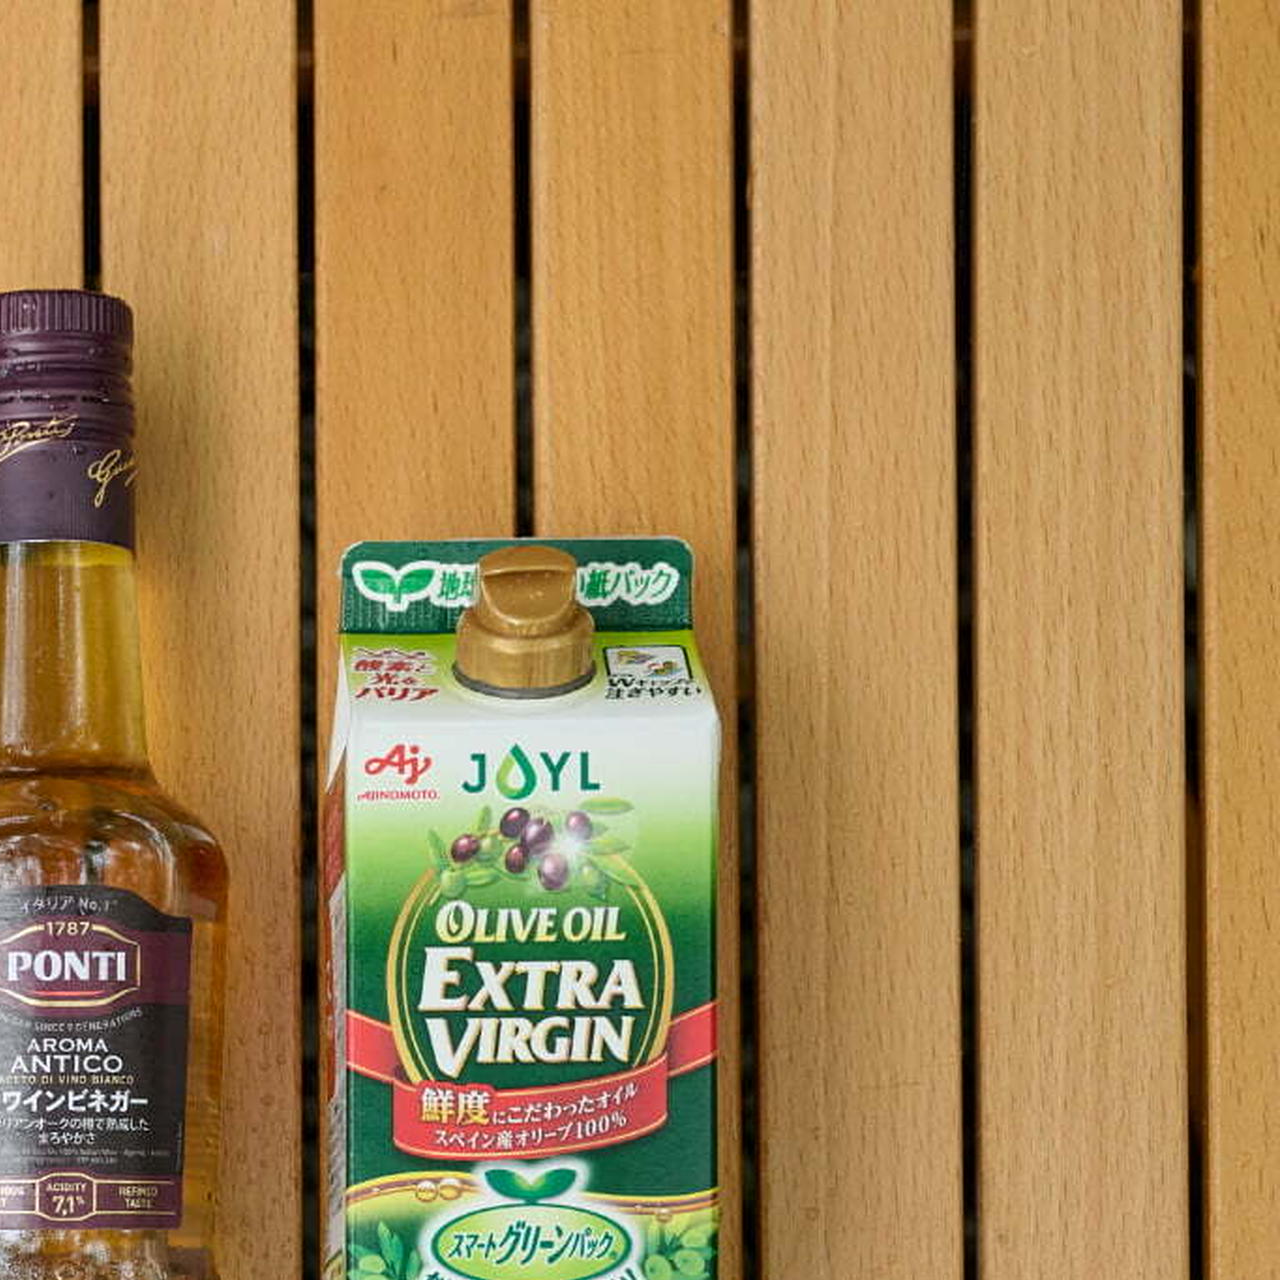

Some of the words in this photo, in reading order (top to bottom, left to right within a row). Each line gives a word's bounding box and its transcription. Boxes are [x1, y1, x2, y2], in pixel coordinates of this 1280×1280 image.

[354, 686, 439, 702] バリア
[20, 895, 76, 914] イタリア
[46, 921, 91, 937] 1787
[435, 900, 558, 944] OLIVE
[562, 906, 627, 942] OIL
[7, 950, 127, 982] PONTI
[417, 946, 646, 1012] EXTRA
[26, 1038, 109, 1053] AROMA
[423, 1015, 637, 1079] VIRGIN
[10, 1055, 124, 1074] ANTICO
[40, 1075, 54, 1085] DI
[58, 1075, 88, 1085] VINO
[91, 1075, 135, 1085] BIANCO
[420, 1082, 639, 1126] 鮮度にこだわったオイル
[38, 1132, 96, 1146] まろやかさ
[45, 1182, 88, 1193] ACIDITY
[118, 1187, 159, 1198] REFINED
[124, 1198, 152, 1209] TASTE
[447, 1219, 614, 1265] スマートグリーンパック
